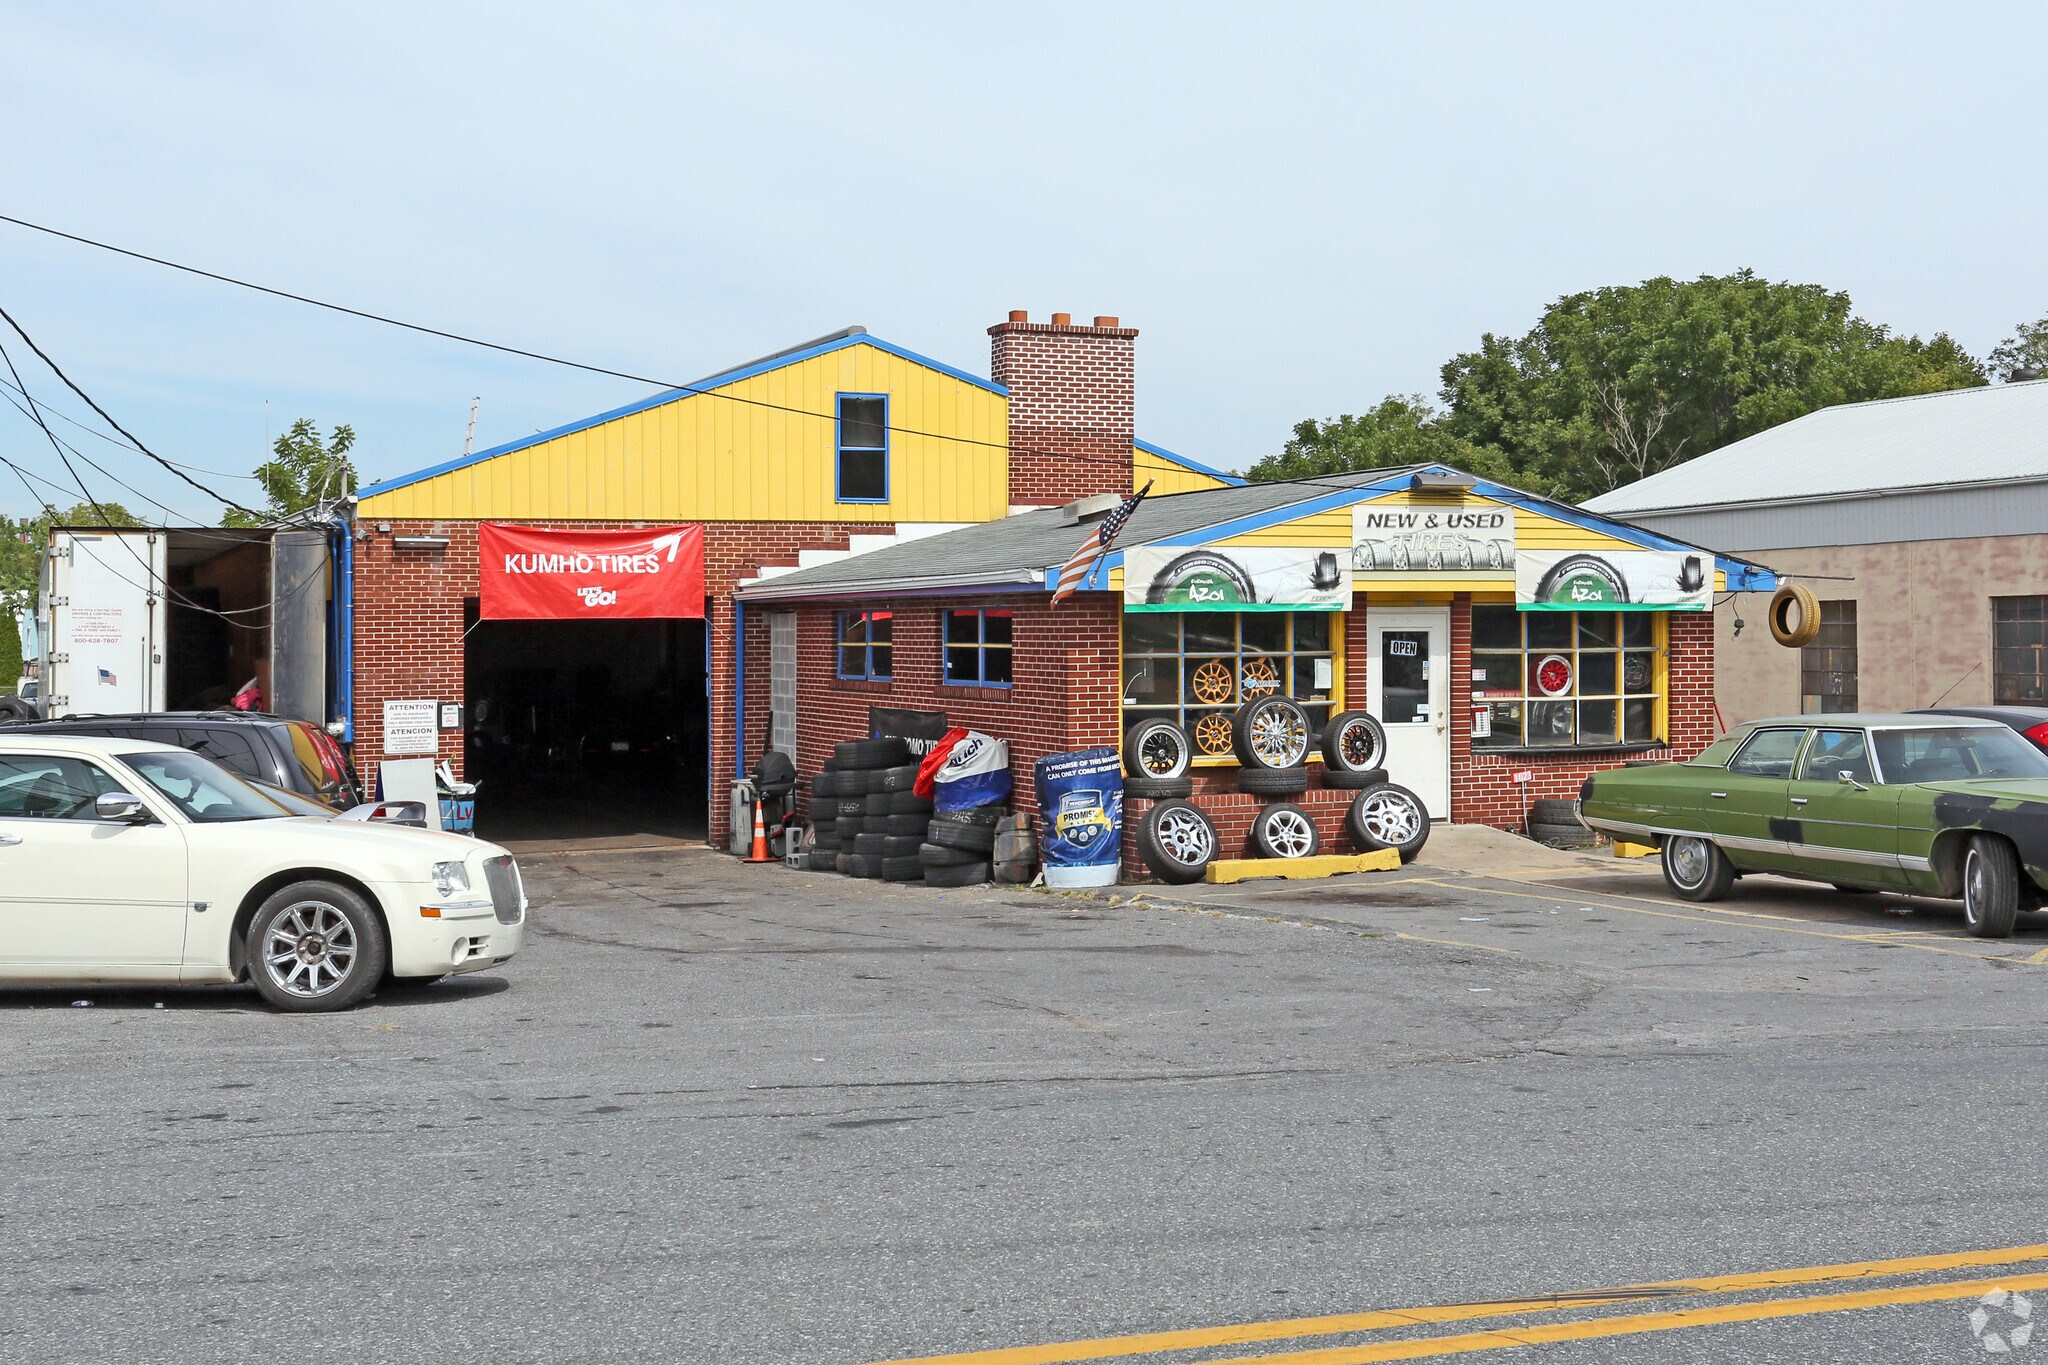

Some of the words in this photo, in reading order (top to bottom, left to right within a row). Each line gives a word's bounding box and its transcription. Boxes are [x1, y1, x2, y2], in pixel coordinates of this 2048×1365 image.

[1366, 513, 1418, 528] NEW
[1424, 513, 1439, 528] &
[1446, 513, 1505, 528] USED
[1393, 532, 1470, 552] TIRES
[505, 553, 594, 574] KUMHO
[596, 553, 660, 574] TIRES
[577, 586, 603, 597] LET'S
[585, 591, 617, 607] GO!
[1393, 641, 1416, 655] OPEN
[1051, 761, 1078, 771] PROMISE
[1089, 757, 1102, 765] THIS
[1047, 773, 1061, 781] CAN
[1061, 769, 1077, 777] ONLY
[1077, 767, 1097, 775] COME
[1097, 765, 1112, 773] FROM
